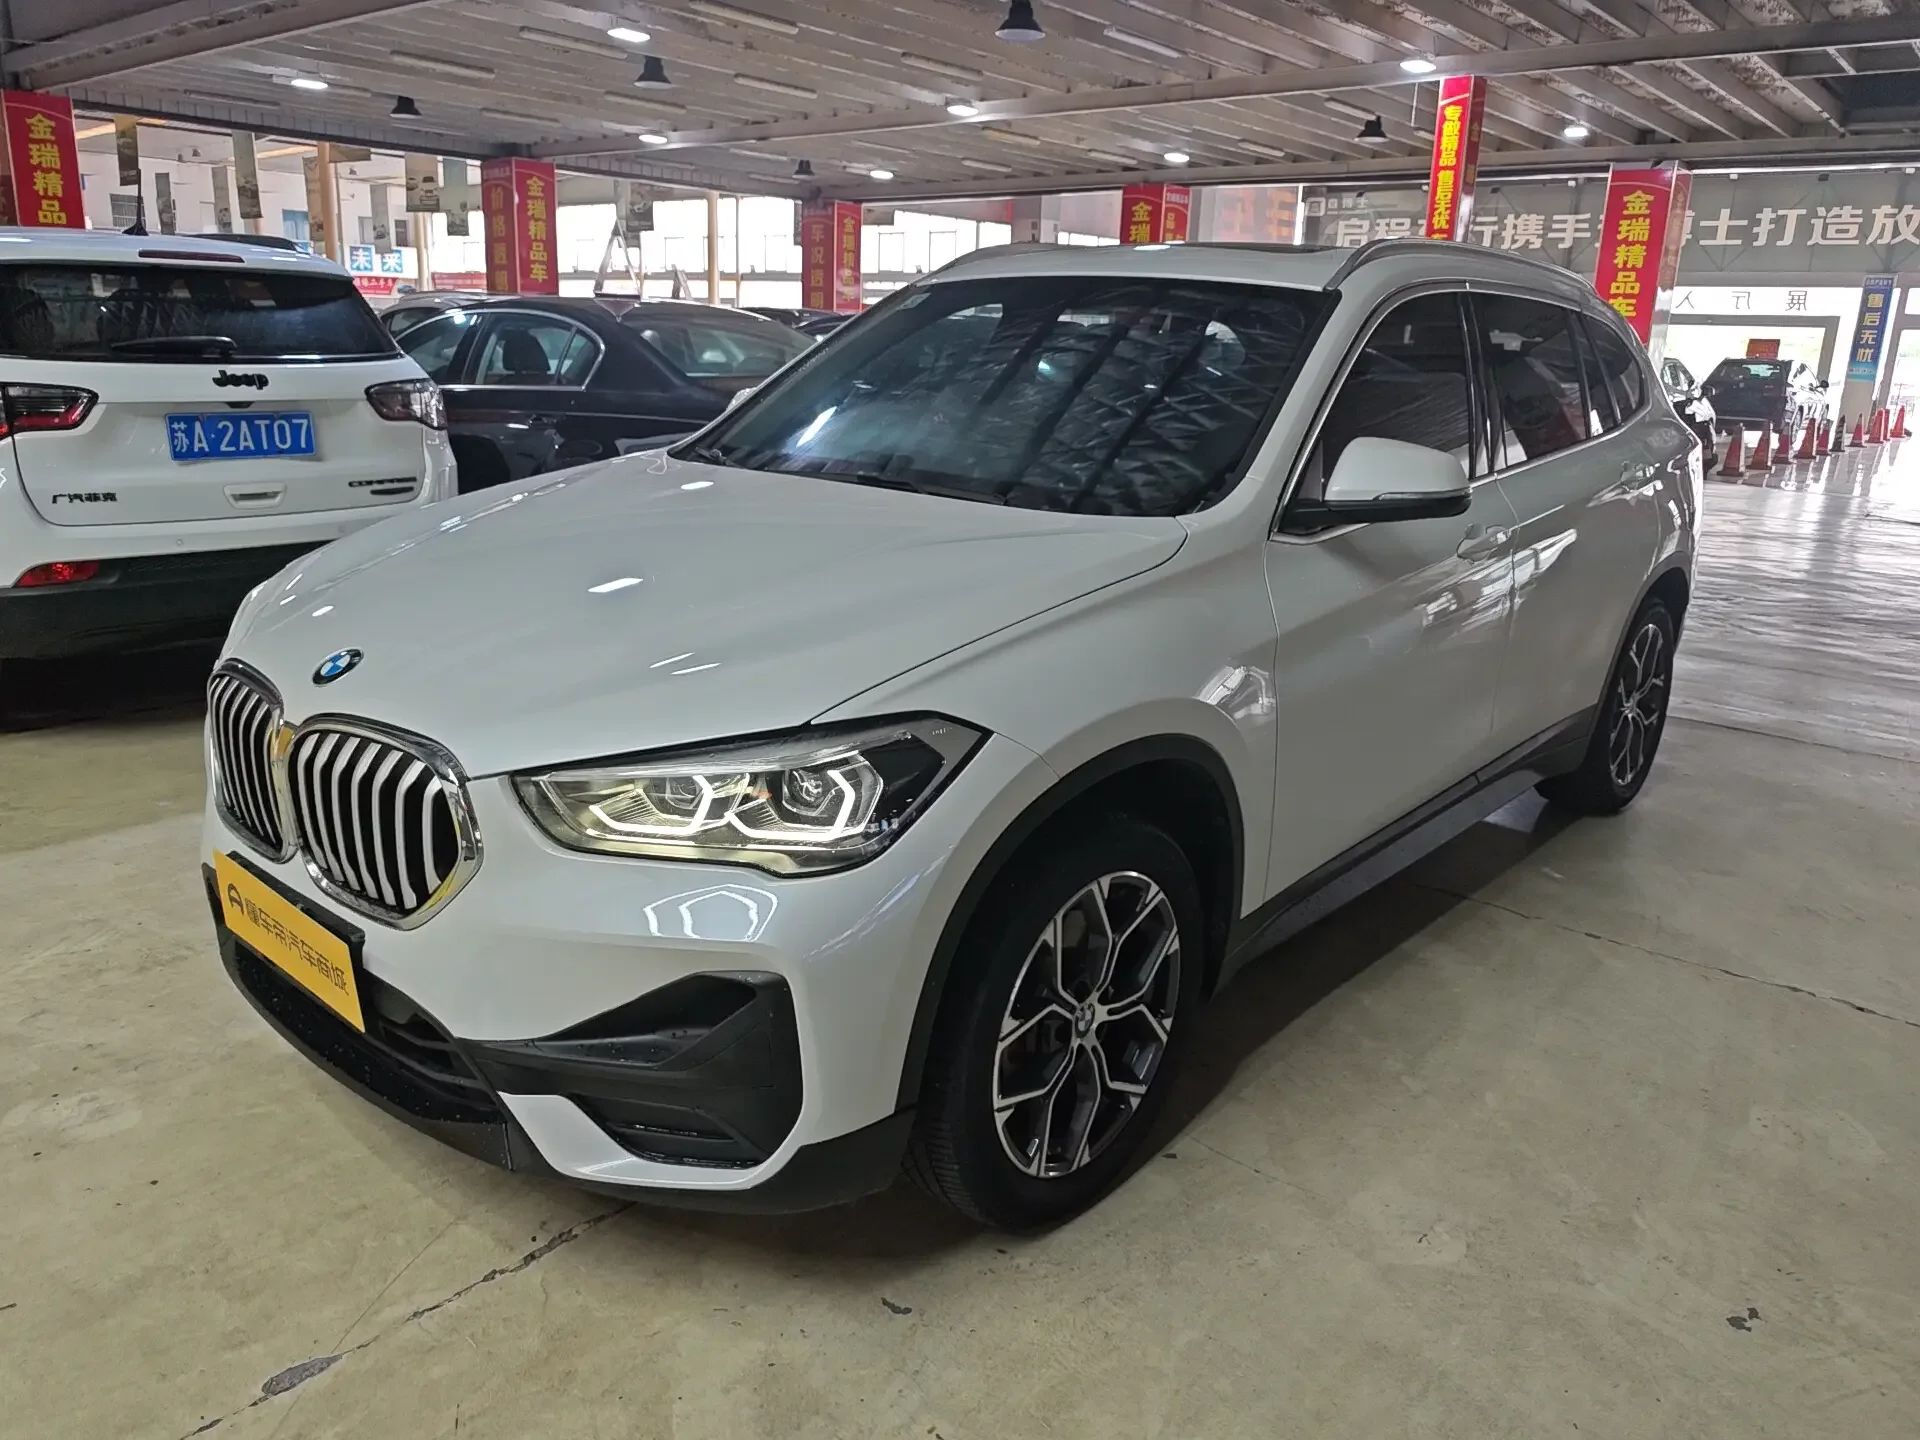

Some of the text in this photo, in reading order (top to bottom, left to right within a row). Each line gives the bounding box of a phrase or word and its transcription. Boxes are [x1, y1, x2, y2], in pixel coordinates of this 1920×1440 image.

[1439, 104, 1464, 167] 专做精品
[25, 113, 67, 225] 金瑞精品
[1431, 169, 1456, 230] 售后无忧
[526, 175, 548, 283] 金瑞精品车
[1129, 201, 1153, 242] 金瑞
[351, 250, 402, 273] 未来
[1608, 189, 1655, 318] 金瑞精品车
[1855, 293, 1885, 363] 售后无忧
[212, 369, 269, 390] Jeep
